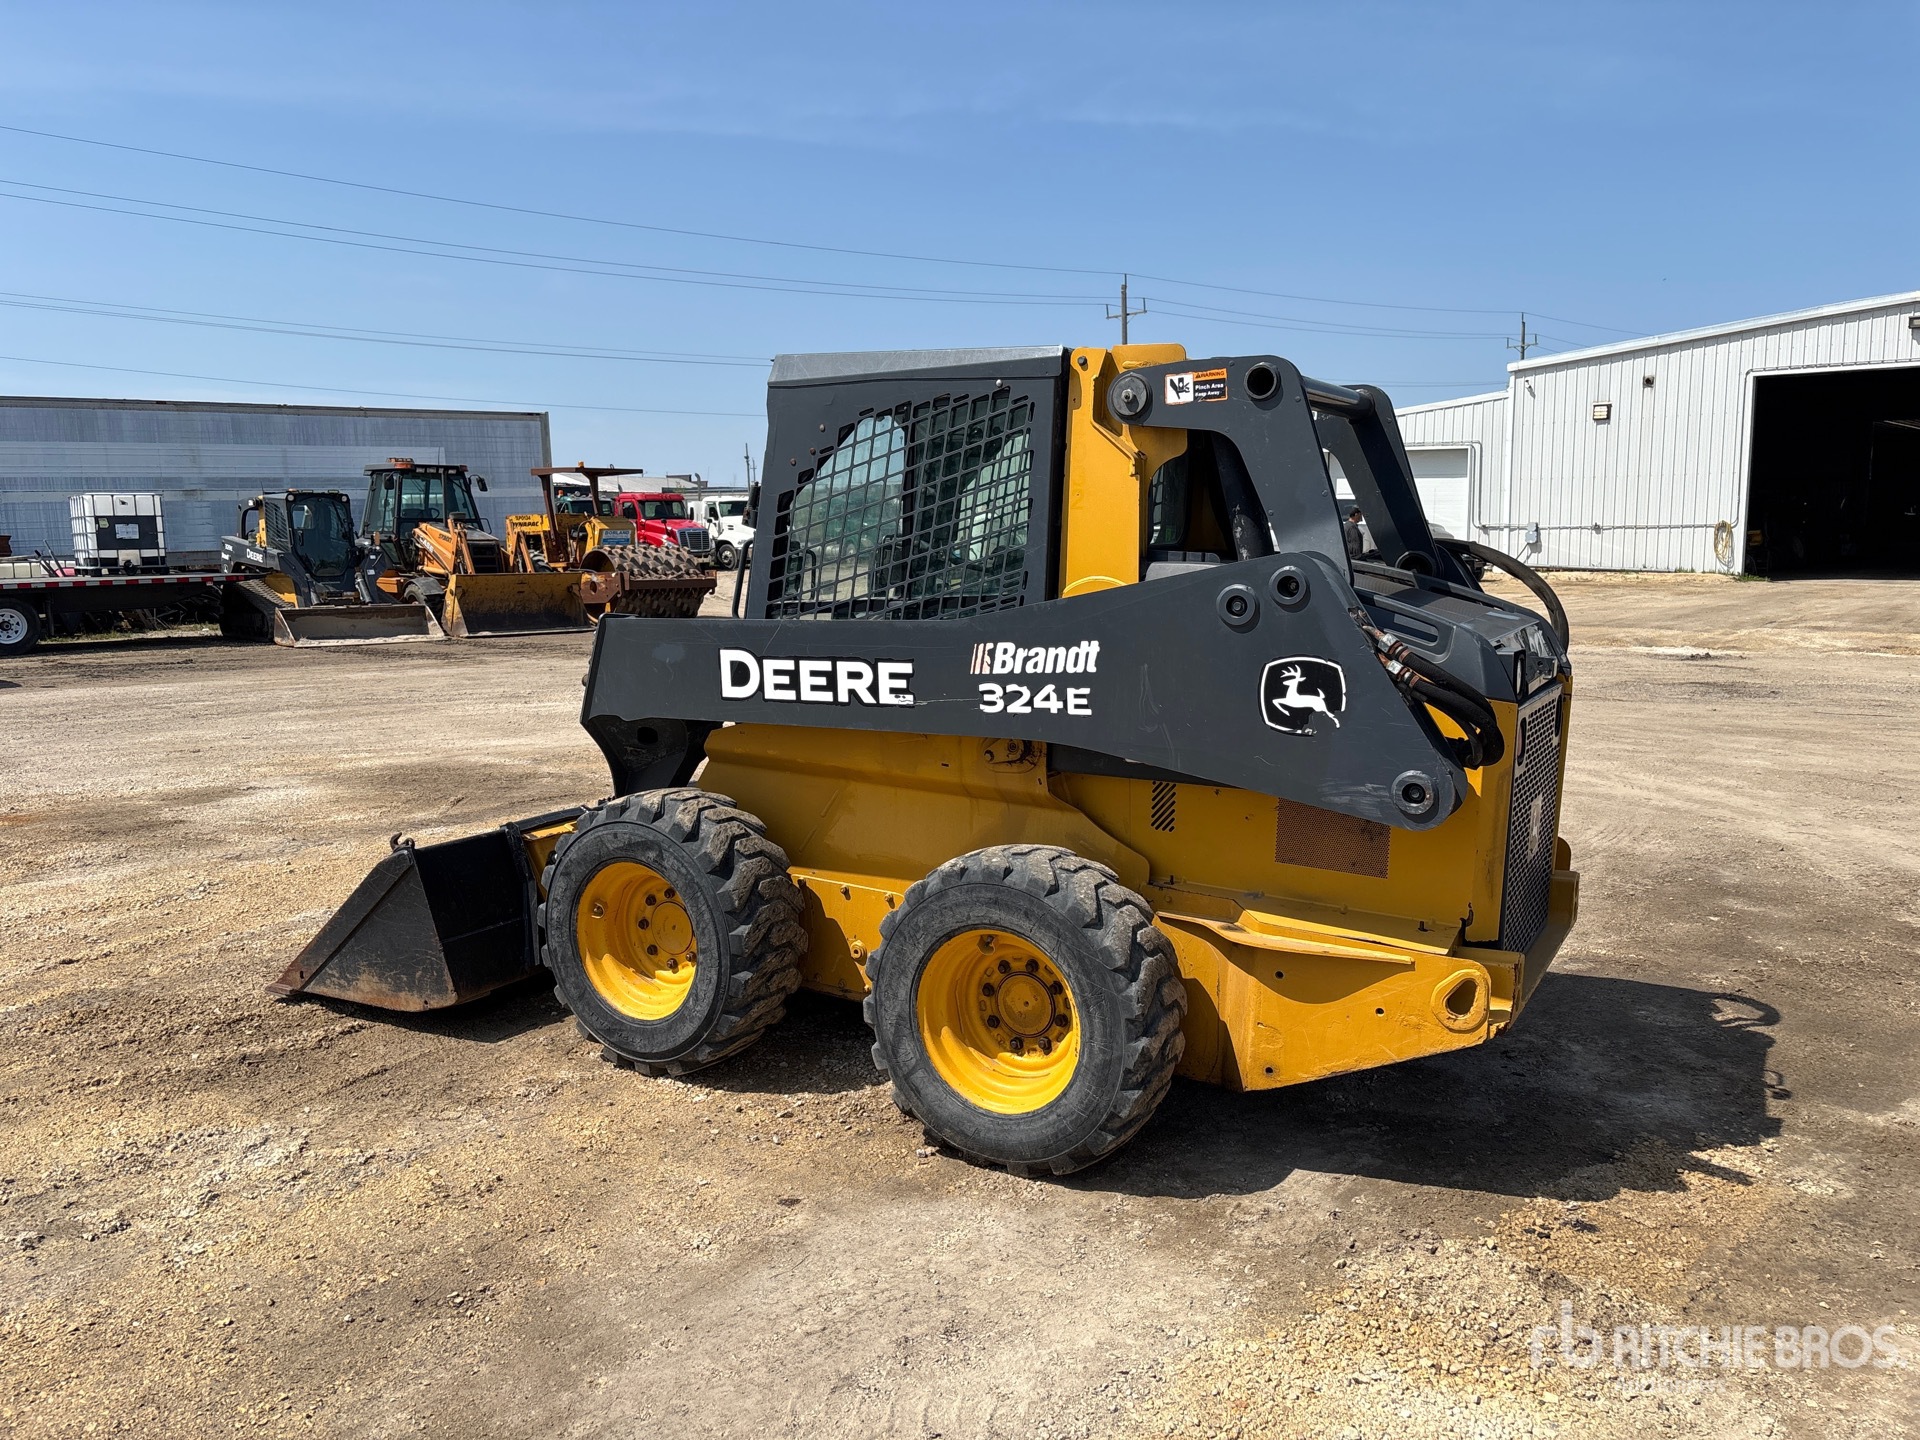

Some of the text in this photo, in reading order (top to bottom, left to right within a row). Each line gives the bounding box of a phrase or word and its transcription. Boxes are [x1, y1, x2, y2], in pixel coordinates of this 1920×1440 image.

[246, 548, 264, 563] DEERE
[992, 640, 1100, 674] Brandt
[720, 648, 914, 706] DEERE
[978, 683, 1093, 716] 324E
